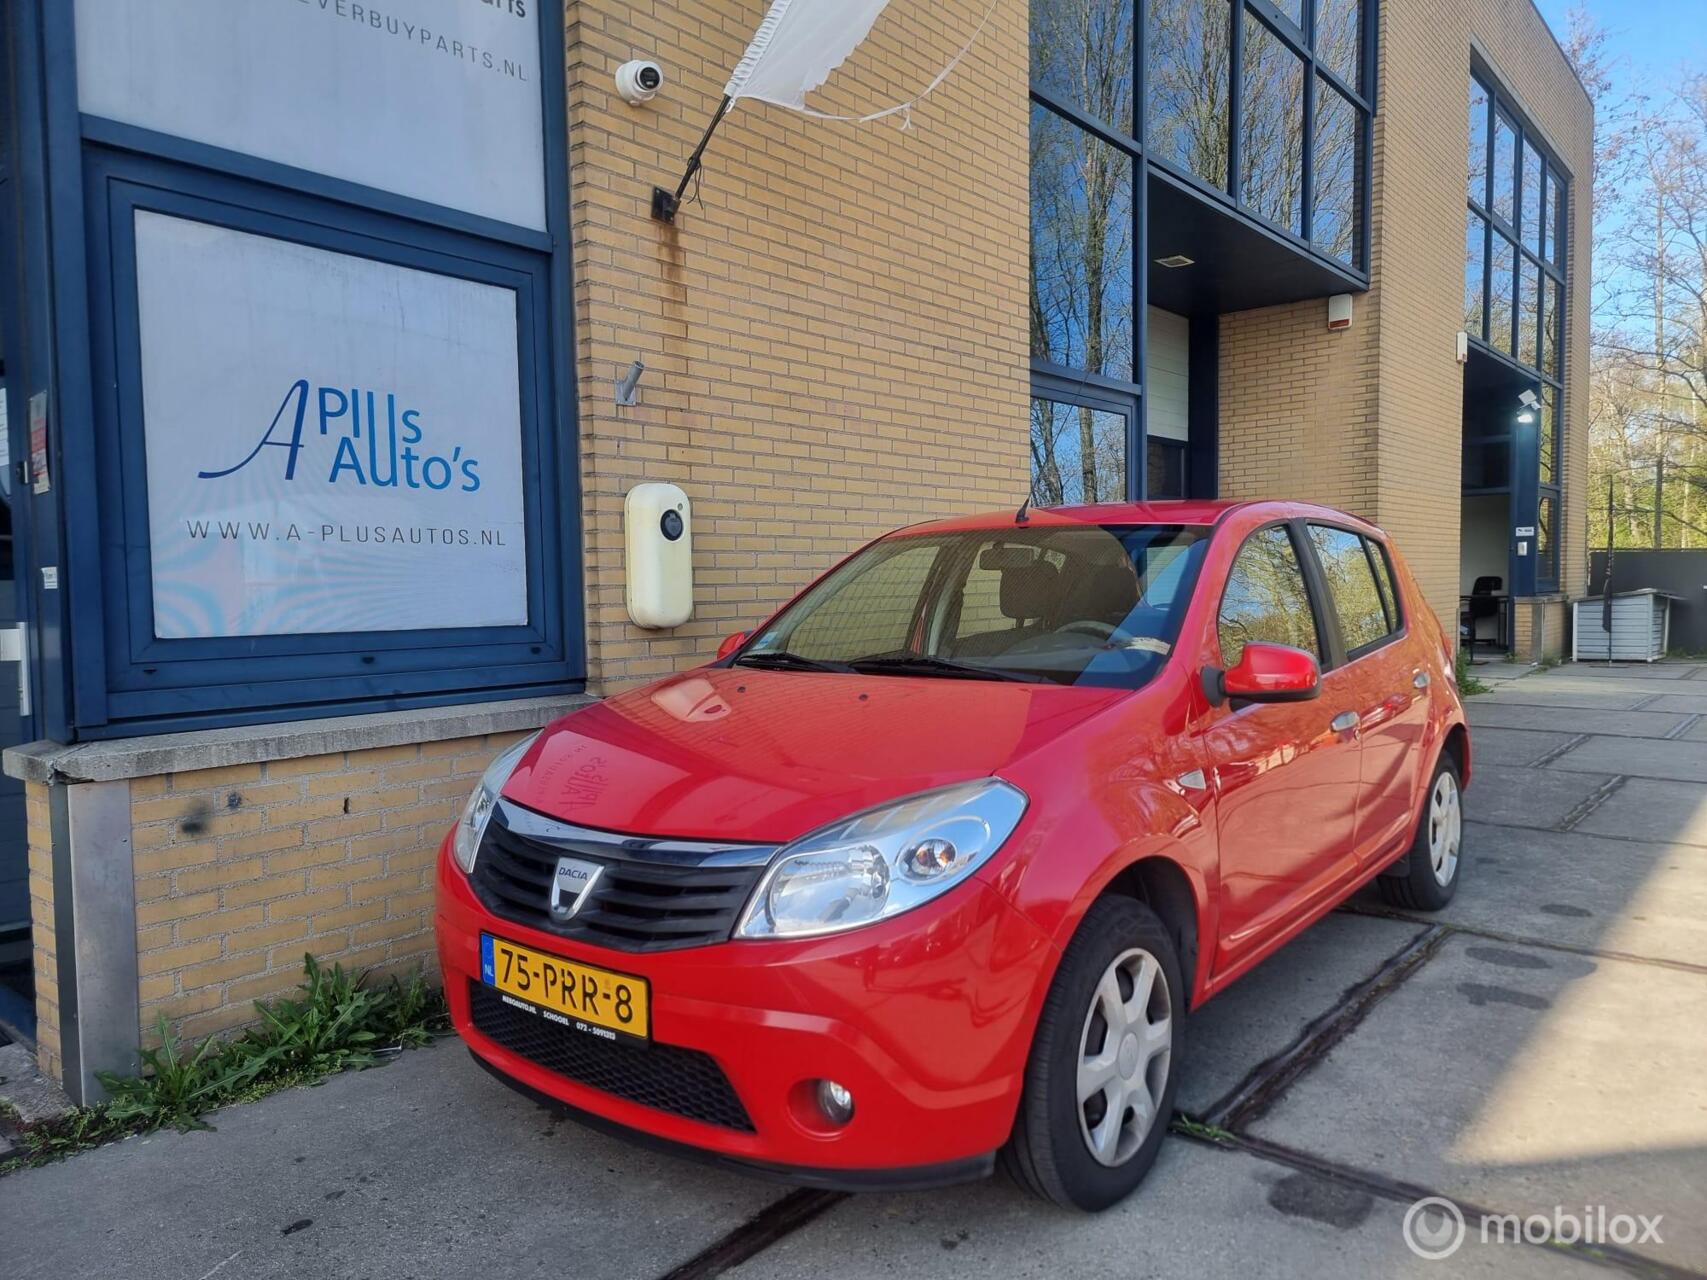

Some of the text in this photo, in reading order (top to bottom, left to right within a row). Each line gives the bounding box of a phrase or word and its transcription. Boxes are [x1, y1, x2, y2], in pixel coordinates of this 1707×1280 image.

[186, 520, 506, 545] WWW.A-PLUSAUTOS.NL
[558, 867, 588, 880] DACIA
[484, 963, 494, 977] NL
[501, 948, 633, 1024] 75-PRR-8
